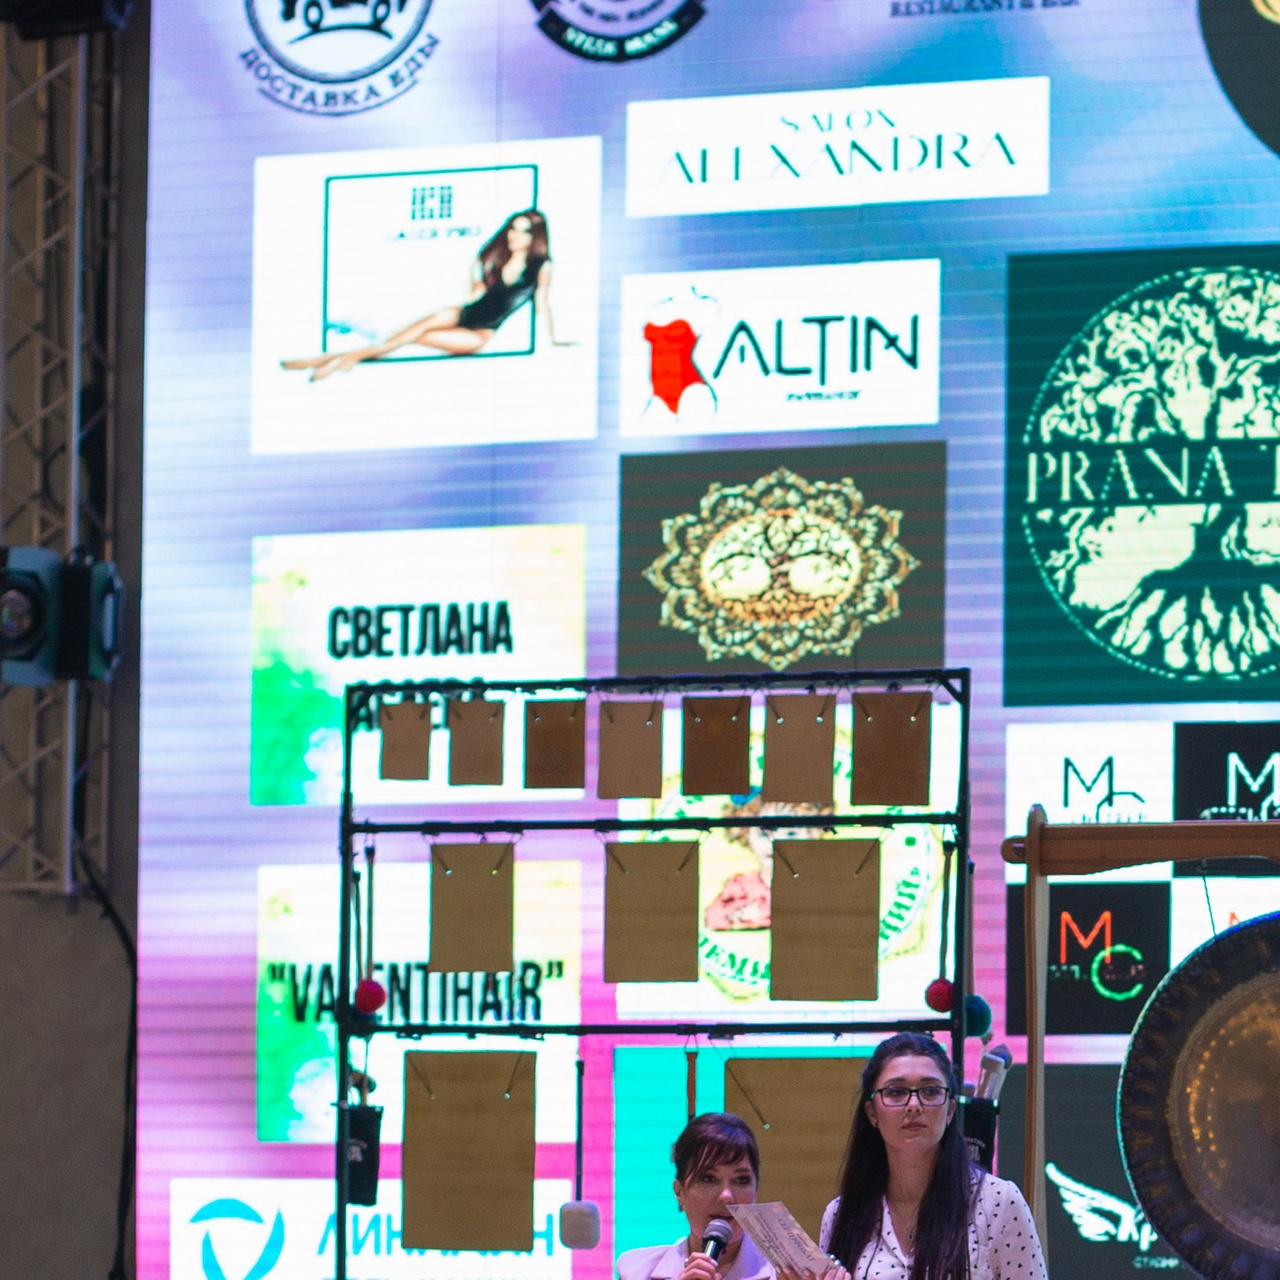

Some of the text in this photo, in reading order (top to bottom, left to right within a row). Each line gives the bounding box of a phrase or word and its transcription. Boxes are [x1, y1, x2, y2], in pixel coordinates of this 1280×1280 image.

[239, 48, 380, 107] ДОСТАВКА
[660, 132, 1016, 184] ALEXANDRA
[713, 314, 919, 386] ALTIN
[1026, 445, 1235, 502] PRANA
[327, 601, 513, 659] СВЕТЛАНА
